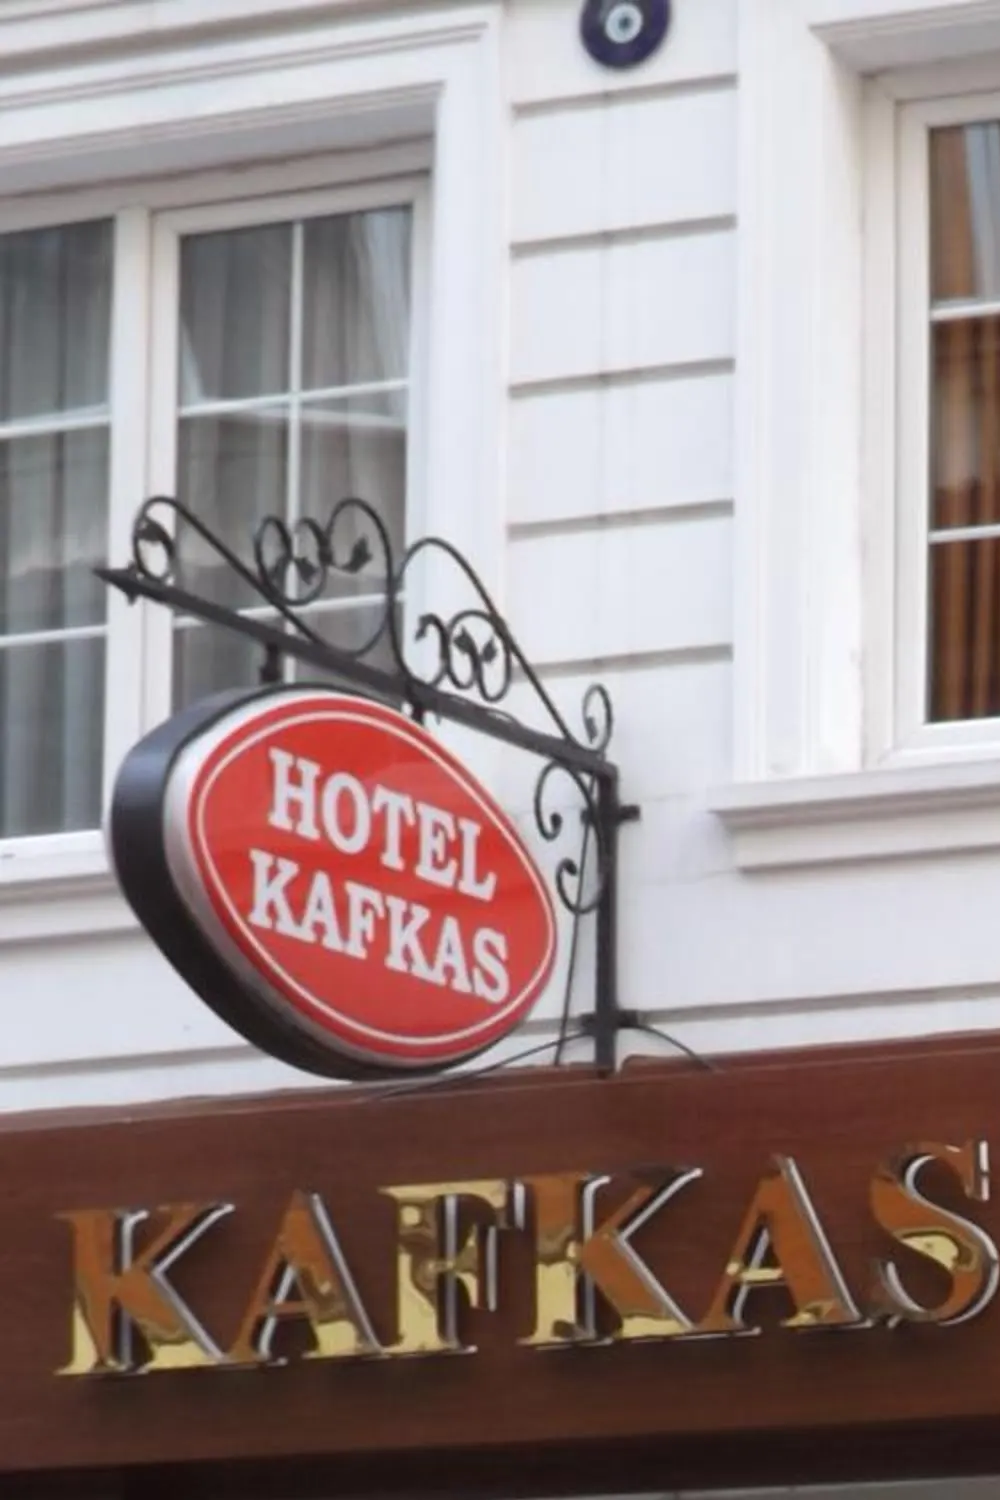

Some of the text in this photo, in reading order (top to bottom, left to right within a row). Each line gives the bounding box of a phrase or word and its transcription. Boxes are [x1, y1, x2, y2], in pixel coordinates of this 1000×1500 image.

[267, 747, 497, 902] HOTEL
[247, 848, 510, 1004] KAFKAS
[53, 1139, 1000, 1377] KAFKAS
